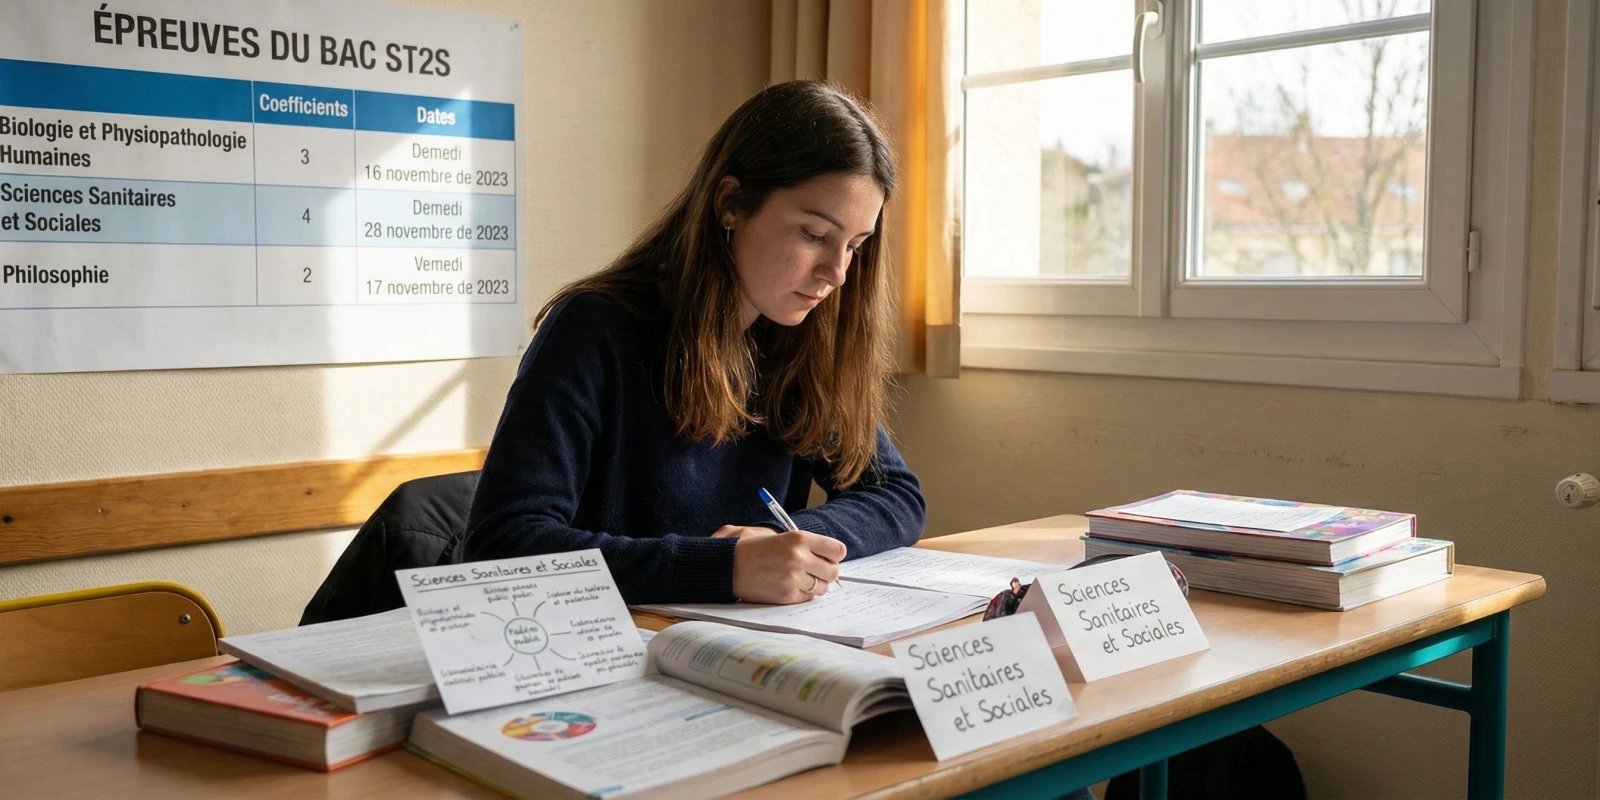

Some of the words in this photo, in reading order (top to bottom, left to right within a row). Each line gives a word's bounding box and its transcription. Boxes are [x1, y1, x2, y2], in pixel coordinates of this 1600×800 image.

[93, 2, 260, 59] ÉPREUVES
[271, 30, 309, 62] DU
[320, 35, 376, 70] BAC
[385, 42, 451, 77] ST2S
[259, 93, 349, 118] Coefficients
[417, 106, 457, 126] Dates
[0, 115, 74, 143] Biologie
[79, 123, 96, 140] et
[101, 122, 247, 153] Physiopathologie
[0, 144, 91, 168] Humaines
[300, 148, 310, 165] 3
[412, 142, 462, 161] Demedi
[364, 163, 382, 181] 16
[386, 168, 452, 184] novembre
[457, 170, 471, 184] de
[476, 170, 509, 187] 2023
[0, 182, 84, 205] Sciences
[88, 185, 176, 208] Sanitaires
[301, 207, 311, 224] 4
[413, 199, 462, 217] Demedi
[2, 213, 19, 230] et
[24, 211, 102, 233] Sociales
[364, 221, 382, 238] 28
[386, 224, 453, 240] novembre
[457, 225, 473, 240] de
[476, 224, 509, 241] 2023
[3, 264, 109, 288] Philosophie
[303, 267, 312, 283] 2
[366, 279, 383, 295] 17
[387, 280, 454, 296] novembre
[458, 281, 473, 294] de
[477, 279, 509, 295] 2023
[411, 574, 467, 588] Sciences
[471, 565, 532, 580] Sanitaires
[536, 560, 548, 573] et
[552, 555, 599, 570] Sociales
[1057, 576, 1131, 606] Sciences
[1078, 597, 1161, 632] Sanitaires
[1102, 633, 1120, 654] et
[1121, 618, 1185, 648] Sociales
[907, 634, 994, 671] Sciences
[927, 660, 1025, 704] Sanitaires
[953, 707, 976, 733] et
[978, 686, 1053, 724] Sociales
